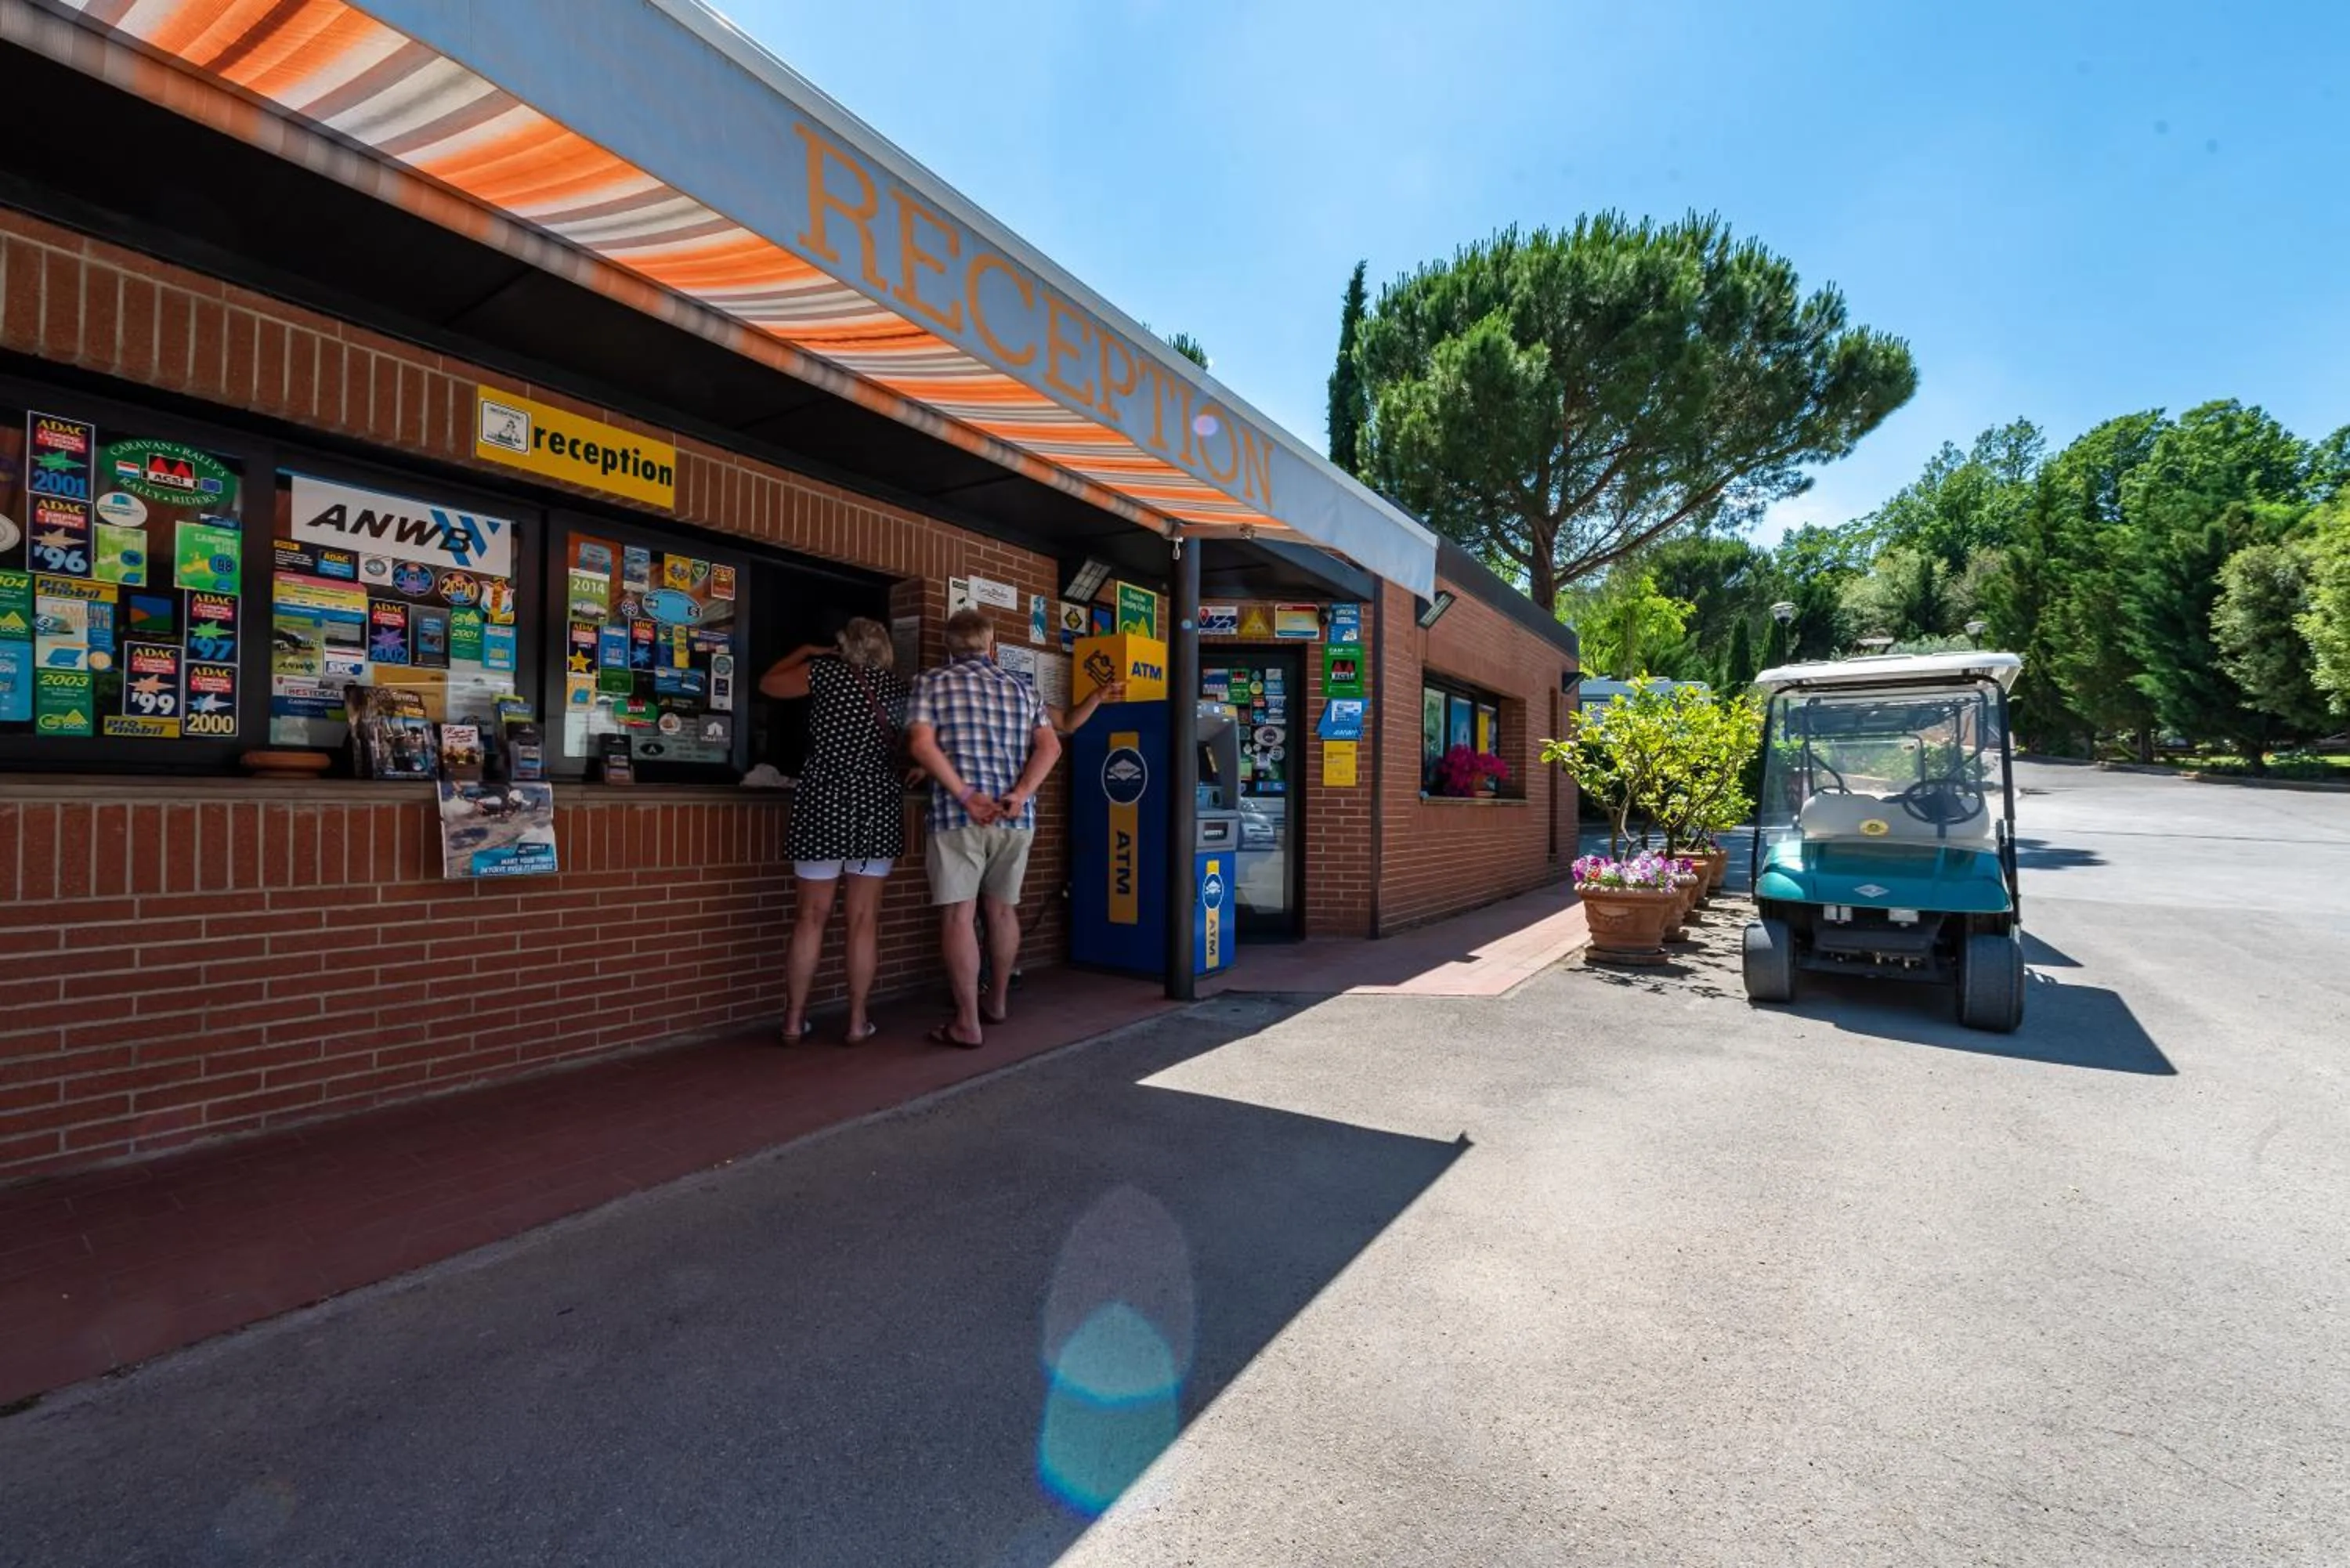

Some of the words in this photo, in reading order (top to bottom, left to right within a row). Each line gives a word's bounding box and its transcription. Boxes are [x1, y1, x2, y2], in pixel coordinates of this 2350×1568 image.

[794, 121, 1274, 511] RECEPTION
[38, 418, 86, 436] ADAC
[110, 441, 172, 457] CARAVAN
[533, 425, 672, 487] reception
[34, 470, 87, 497] 2001
[119, 477, 160, 500] RALLY
[171, 493, 218, 506] RIDERS
[38, 498, 86, 515] ADAC
[306, 504, 470, 553] ANWB
[573, 578, 606, 595] 2014
[195, 593, 235, 605] ADAC
[374, 603, 404, 613] ADAC
[132, 648, 176, 659] ADAC
[371, 646, 407, 662] 2002
[191, 667, 233, 678] ADAC
[1131, 662, 1162, 681] ATM
[40, 674, 89, 687] 2003
[187, 714, 234, 734] 2000
[1116, 830, 1130, 895] ATM
